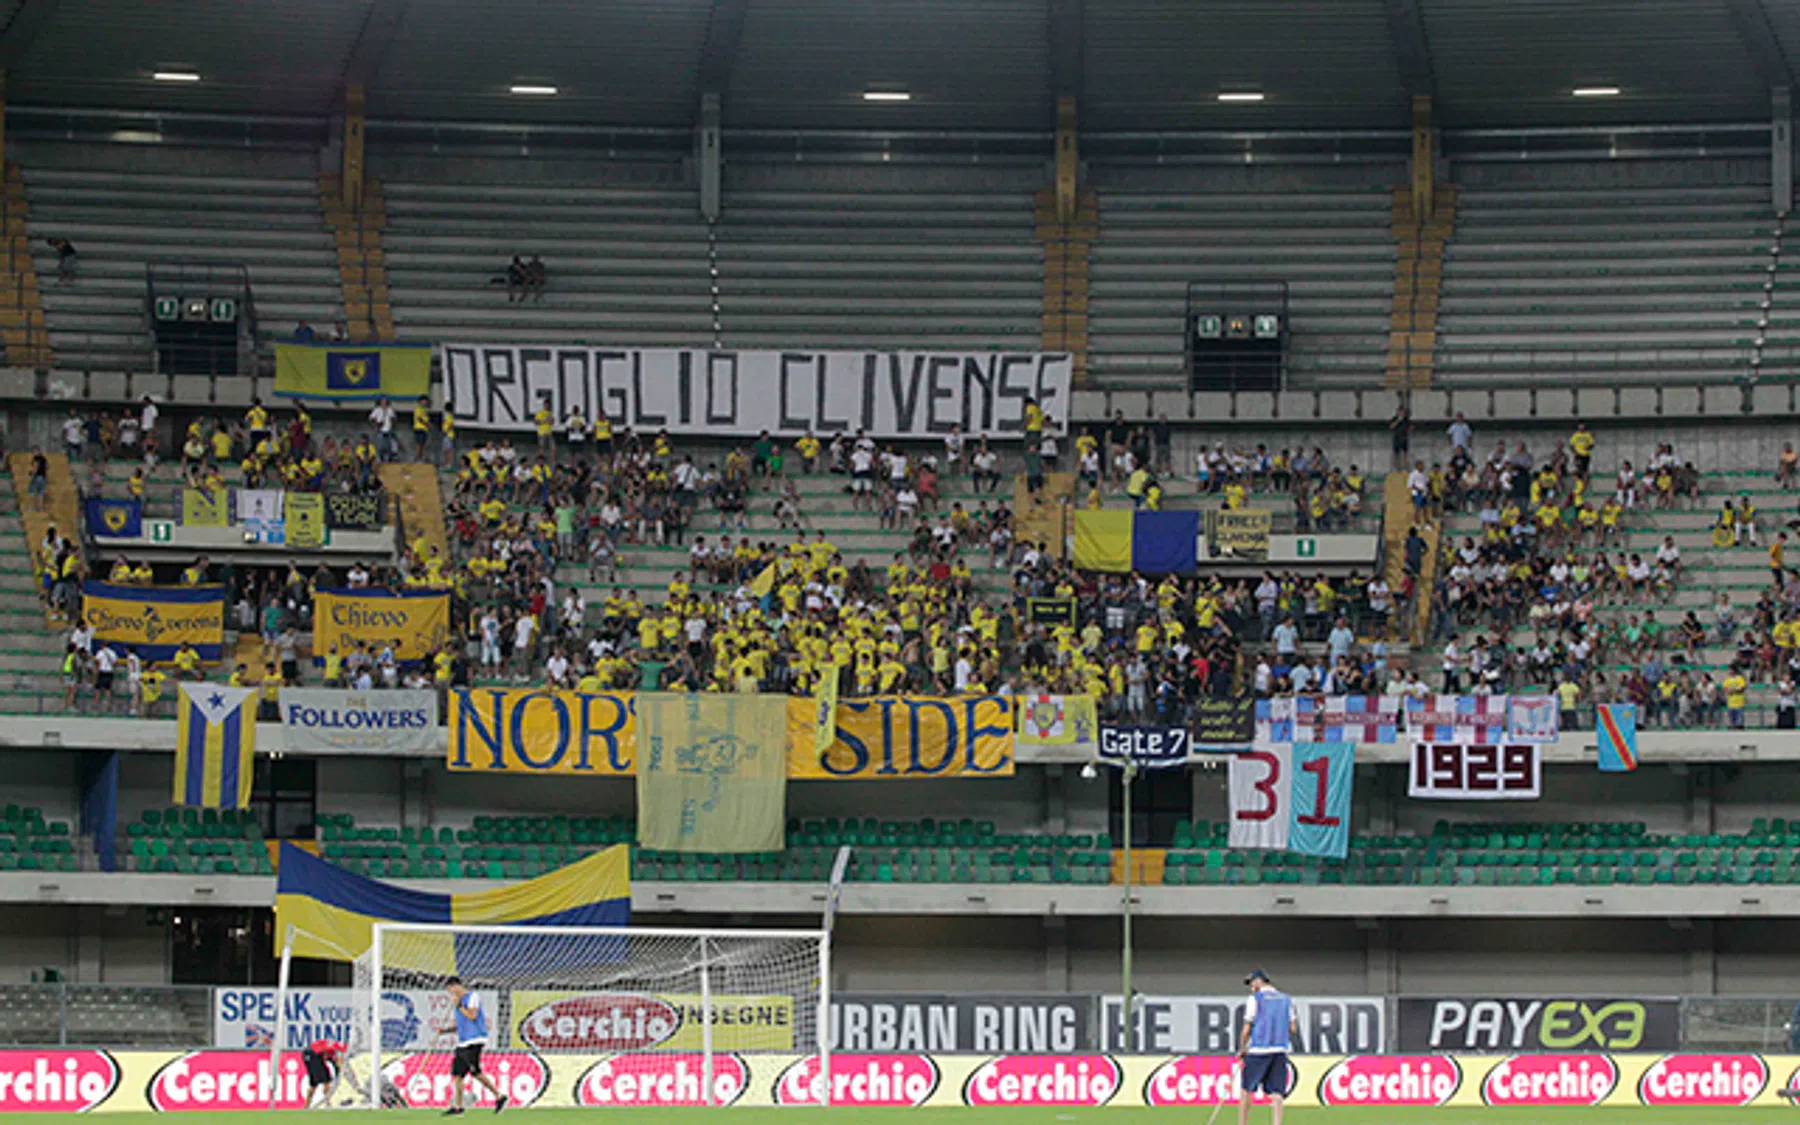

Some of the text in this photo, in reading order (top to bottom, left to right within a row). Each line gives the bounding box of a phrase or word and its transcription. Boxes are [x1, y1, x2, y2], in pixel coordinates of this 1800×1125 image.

[446, 348, 1069, 435] ORGOGLIO CLIVENSE
[86, 607, 145, 631] Chievo
[332, 600, 409, 629] Chievo
[288, 703, 428, 729] FOLLOWERS
[820, 696, 1011, 775] SIDE
[1101, 727, 1187, 755] Gate 7
[1414, 743, 1535, 790] 1929
[318, 1006, 353, 1022] YOU
[533, 1005, 669, 1041] Cerchio
[975, 1004, 1077, 1052] RING
[1107, 1003, 1172, 1053] BE
[977, 1061, 1111, 1101] Cerchio
[1330, 1061, 1450, 1100] Cerchio
[1491, 1060, 1608, 1099] Cerchio
[1648, 1060, 1760, 1098] Cerchio
